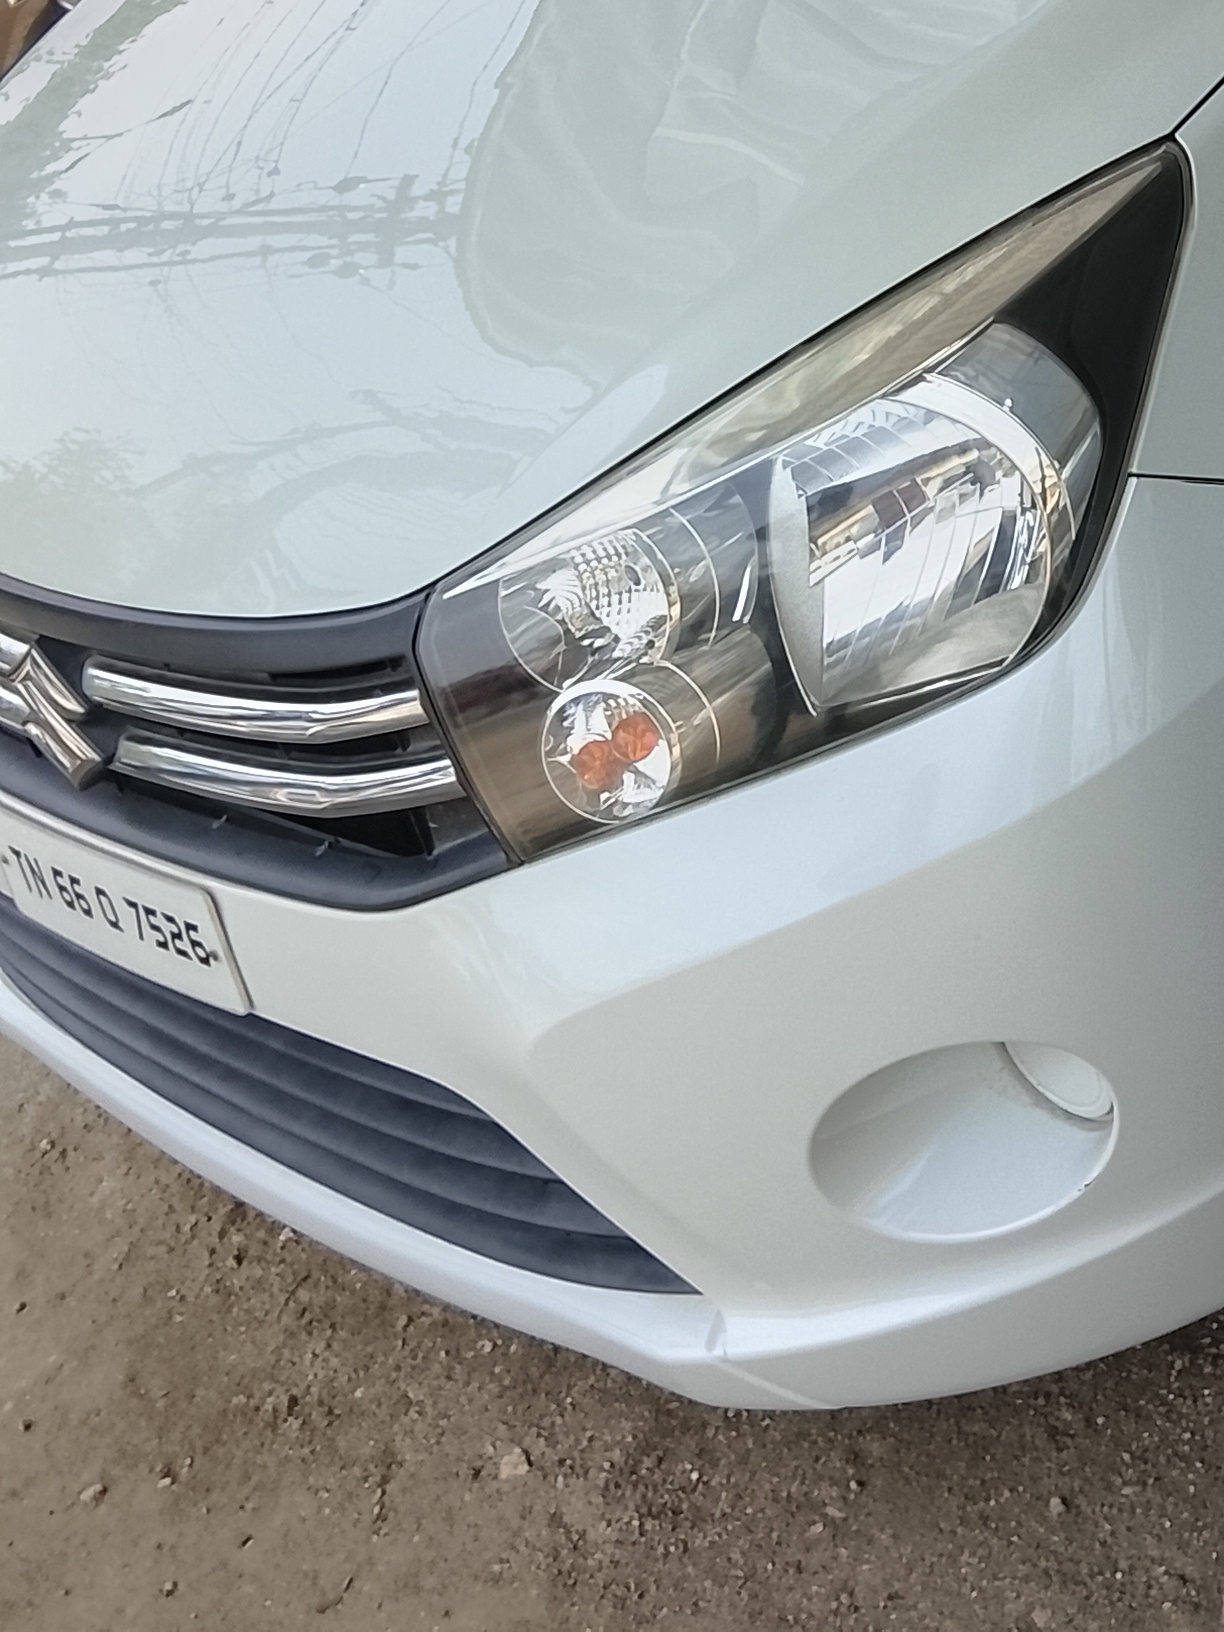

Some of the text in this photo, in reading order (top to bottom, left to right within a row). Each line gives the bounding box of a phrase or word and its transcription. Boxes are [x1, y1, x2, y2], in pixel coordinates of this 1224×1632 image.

[8, 845, 212, 968] TN 66 Q 7526
